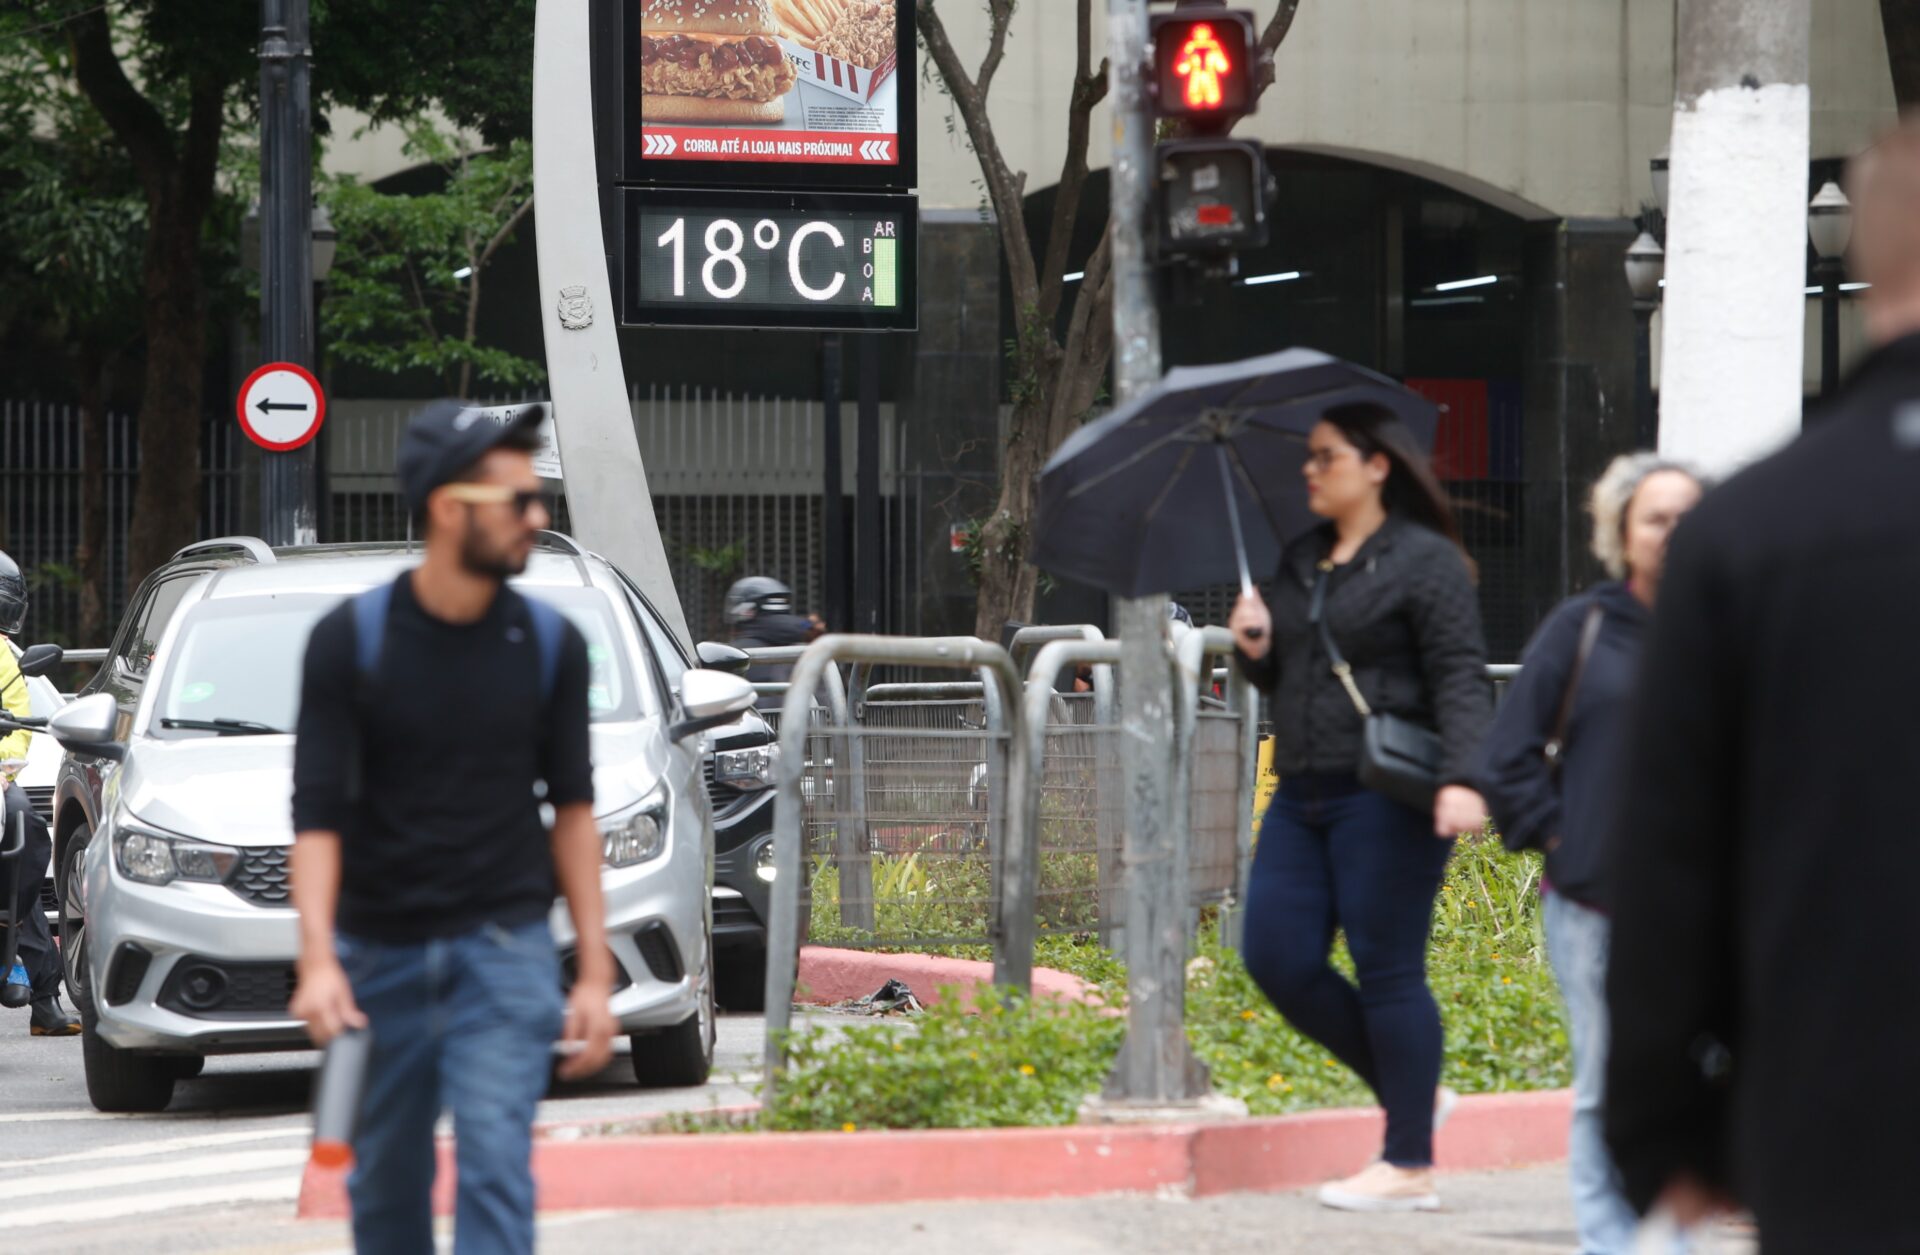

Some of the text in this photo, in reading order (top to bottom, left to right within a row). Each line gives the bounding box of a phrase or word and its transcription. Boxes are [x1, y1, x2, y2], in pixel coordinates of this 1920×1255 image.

[683, 137, 853, 157] CORRA ATÉ A LOJA MAIS PRÓXIMA!
[874, 221, 895, 237] AR
